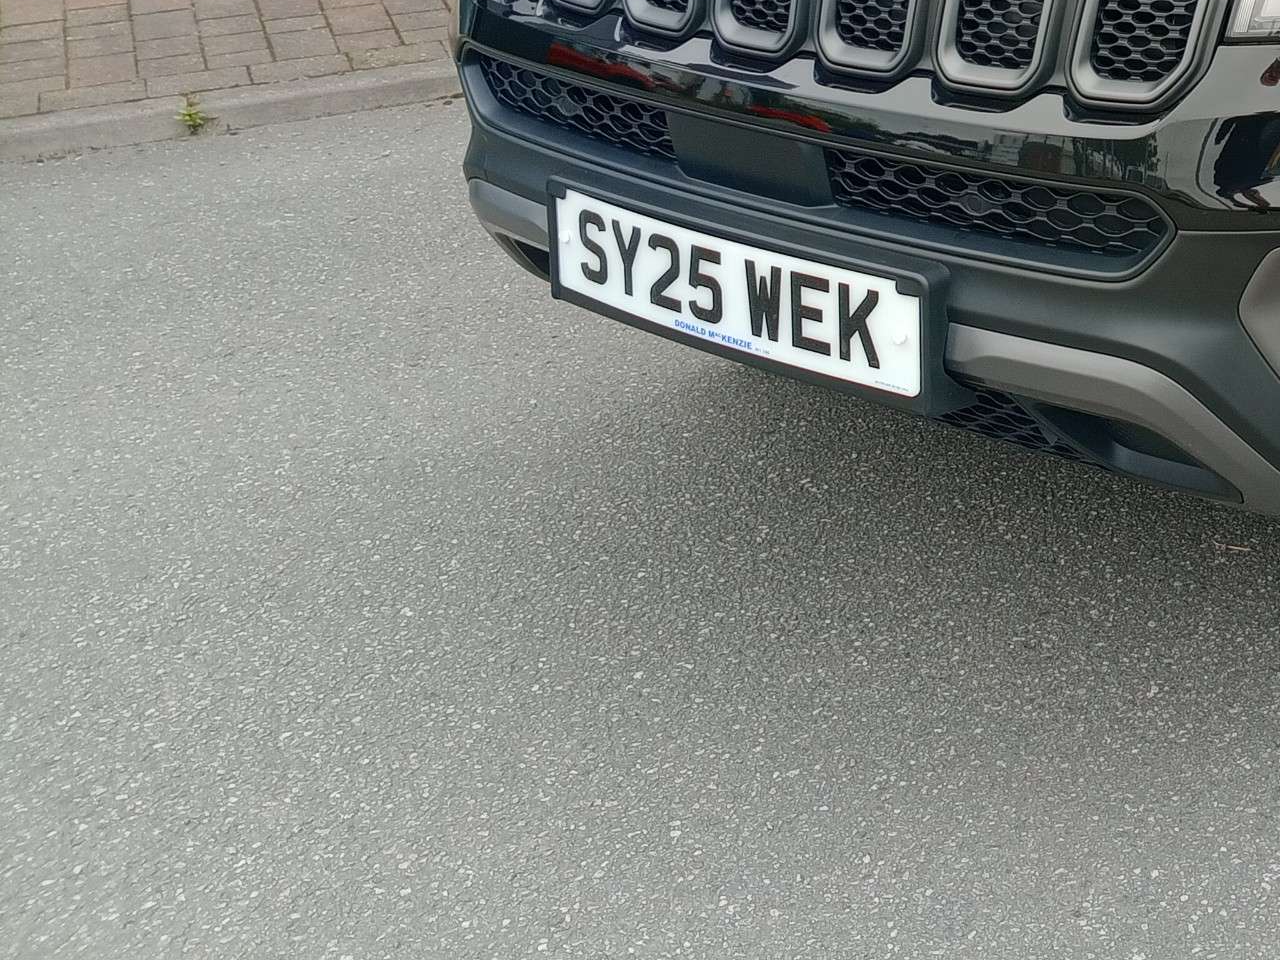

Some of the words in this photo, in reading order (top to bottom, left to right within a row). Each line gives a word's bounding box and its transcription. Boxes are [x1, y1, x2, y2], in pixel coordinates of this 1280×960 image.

[578, 208, 723, 325] SY25
[744, 258, 881, 370] WEK
[674, 319, 707, 336] DONALD
